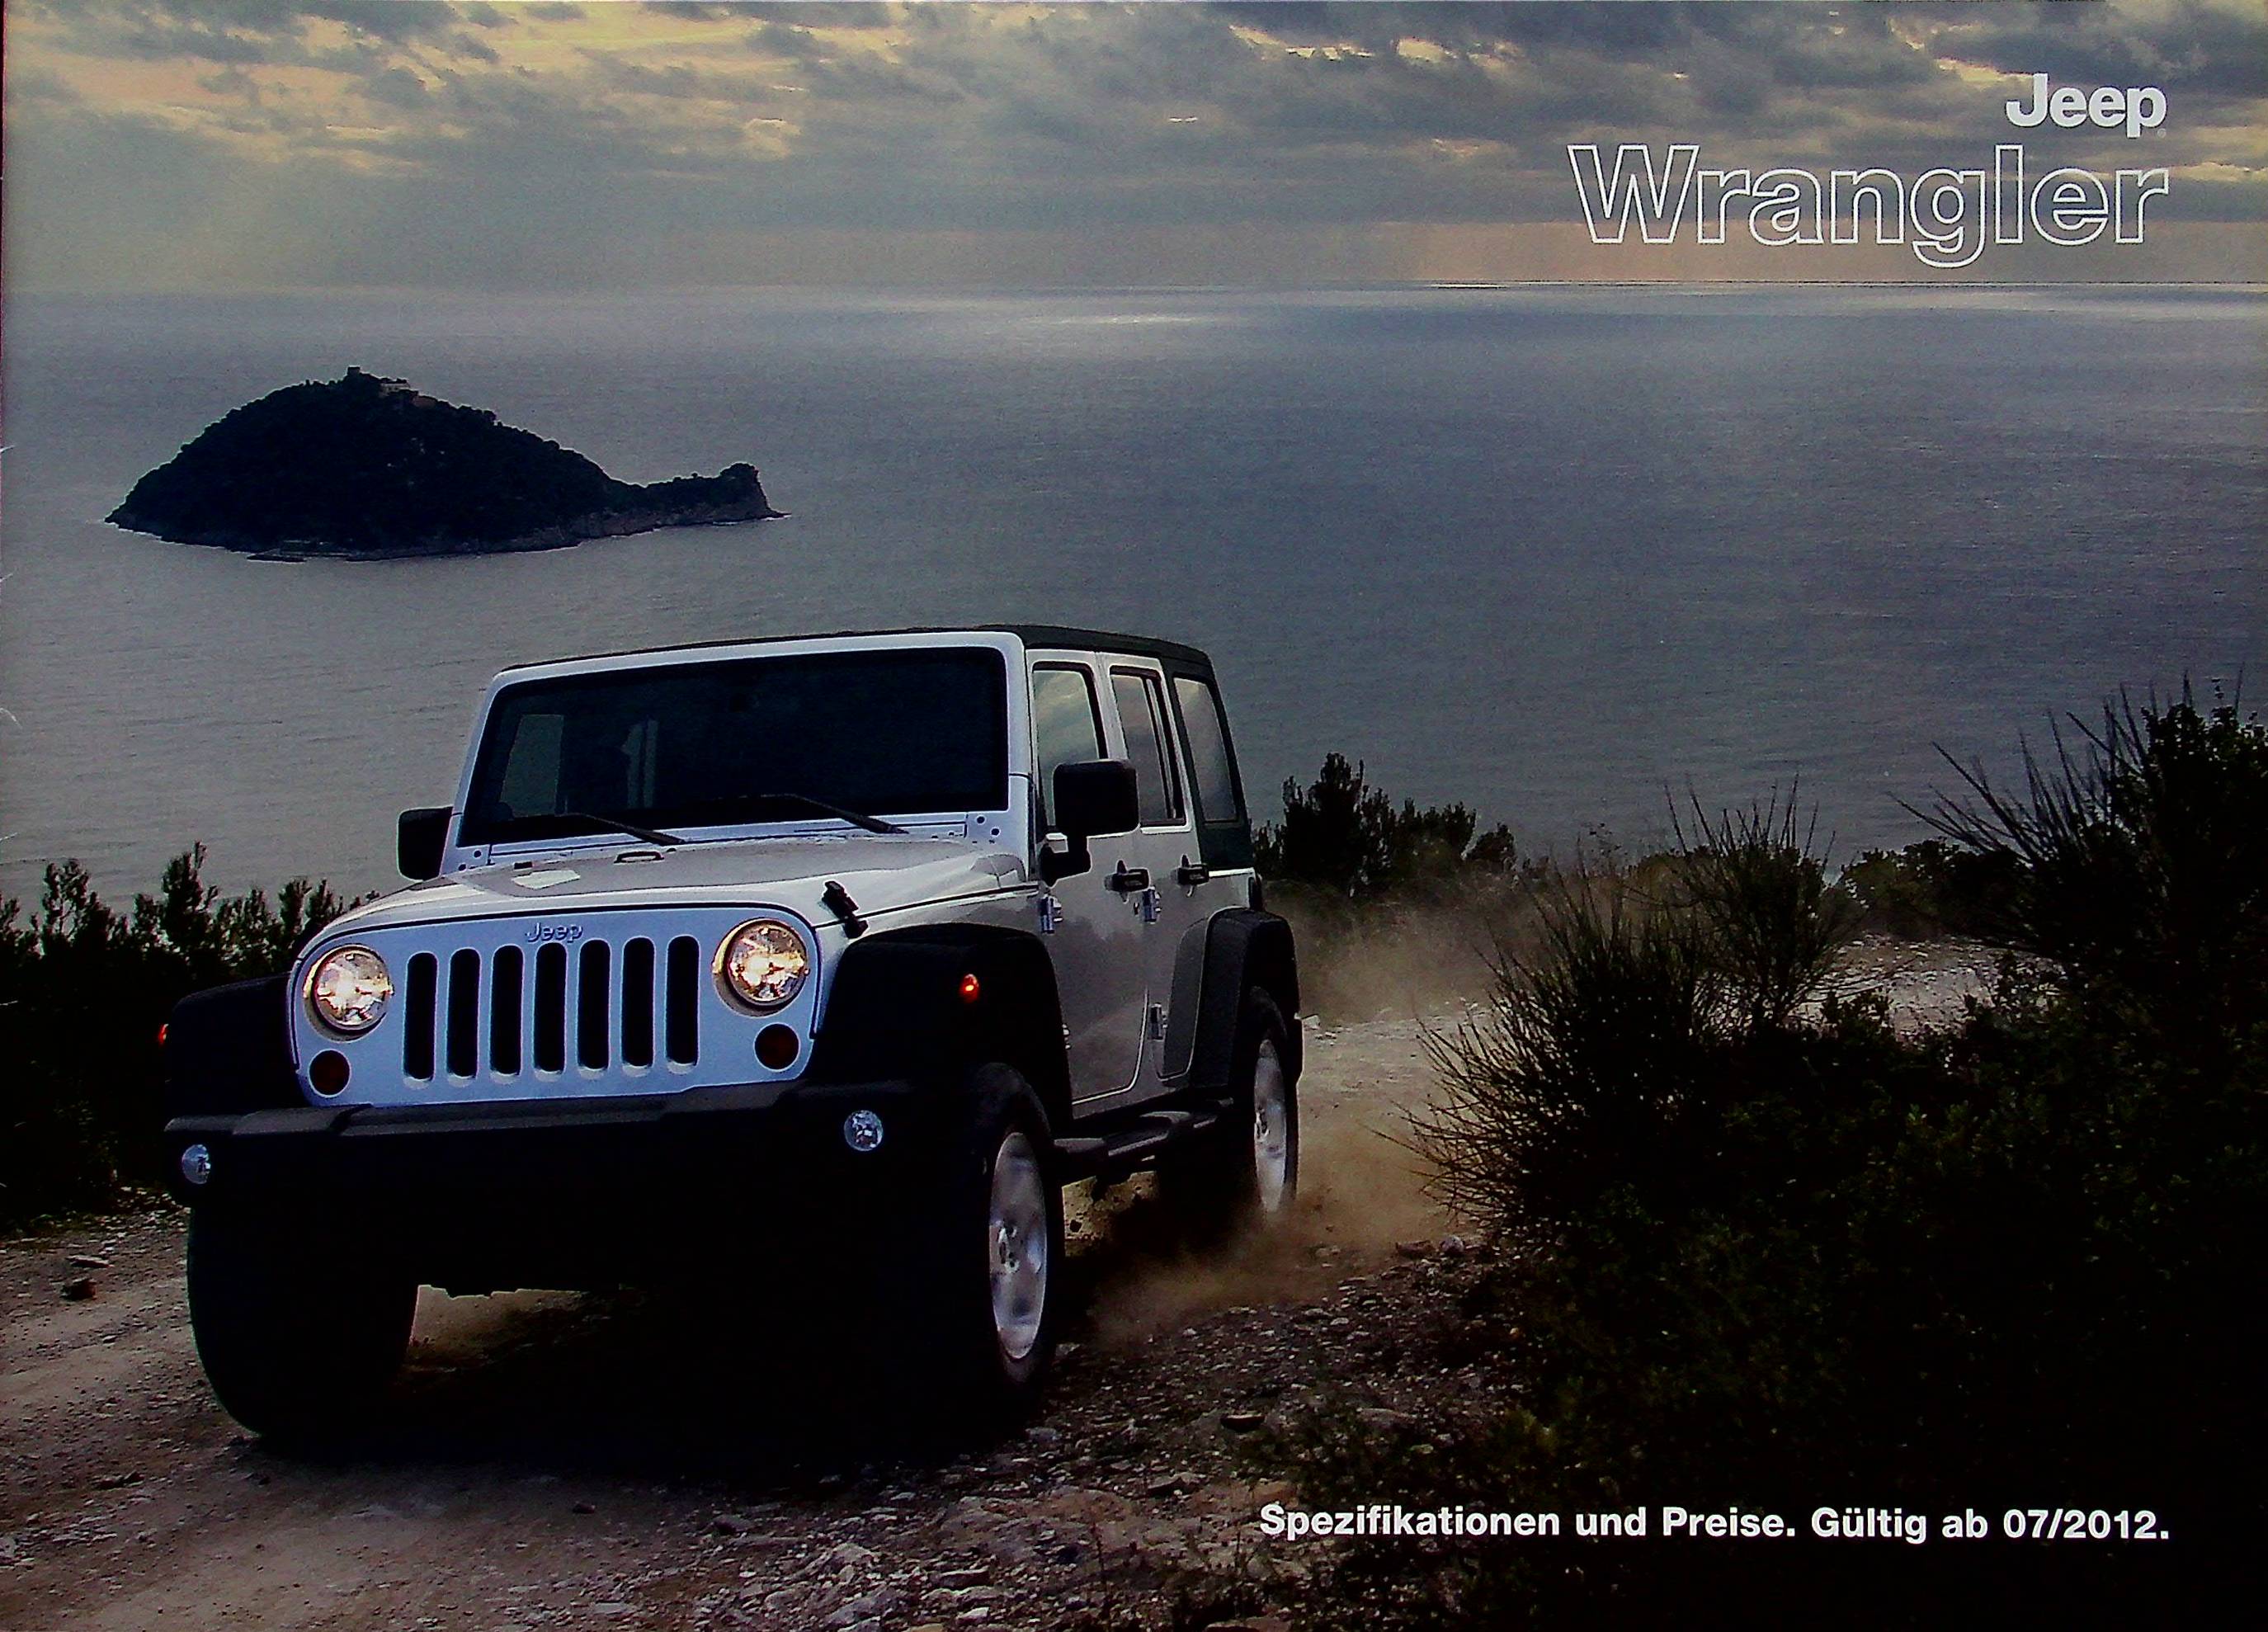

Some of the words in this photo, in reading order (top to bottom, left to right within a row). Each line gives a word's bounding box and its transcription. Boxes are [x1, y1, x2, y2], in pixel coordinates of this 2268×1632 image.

[2006, 73, 2167, 138] Jeep
[1568, 144, 2169, 268] Wrangler
[525, 922, 582, 943] Jeep
[1259, 1503, 1560, 1541] Spezifikationen
[1575, 1507, 1647, 1537] und
[1662, 1507, 1796, 1538] Preise.
[1811, 1507, 1927, 1545] Gültig
[1941, 1508, 1988, 1539] ab
[2002, 1508, 2171, 1540] 07/2012.
